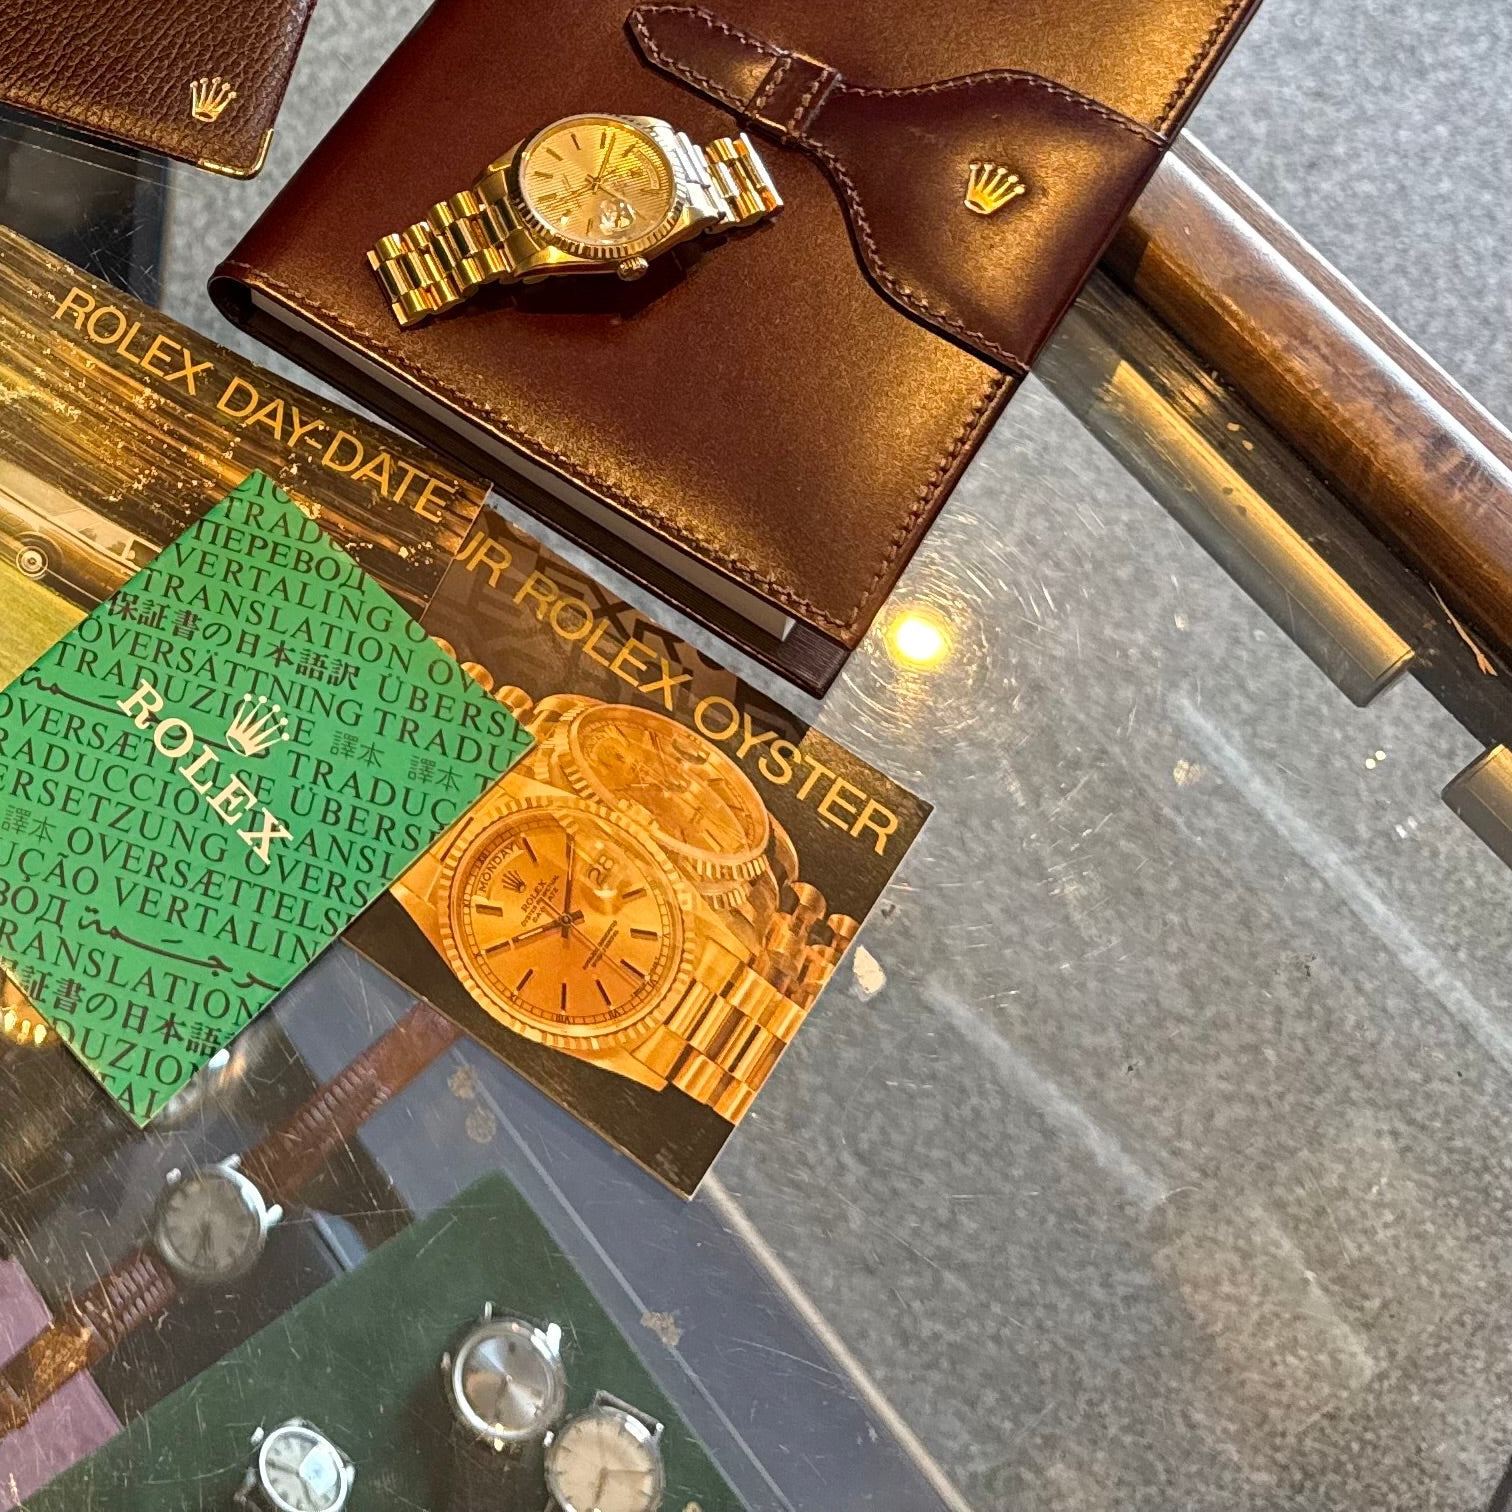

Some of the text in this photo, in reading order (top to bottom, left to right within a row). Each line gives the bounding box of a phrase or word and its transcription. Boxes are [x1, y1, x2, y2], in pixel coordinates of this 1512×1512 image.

[53, 285, 458, 523] ROLEX DAY-DATE
[174, 543, 393, 633] VERTALING
[192, 518, 369, 596] ПЕРЕВОД
[78, 614, 363, 727] ÖVERSÄTTNING
[108, 589, 361, 691] 保証書の日本語訳
[140, 567, 498, 702] TRANSLATION OV
[54, 640, 316, 748] TRADUZIONE
[512, 569, 693, 712] ROLEX
[693, 695, 899, 856] OYSTER
[116, 678, 294, 865] ROLEX
[114, 876, 321, 965] VERTALIN
[520, 879, 547, 913] ROLEX
